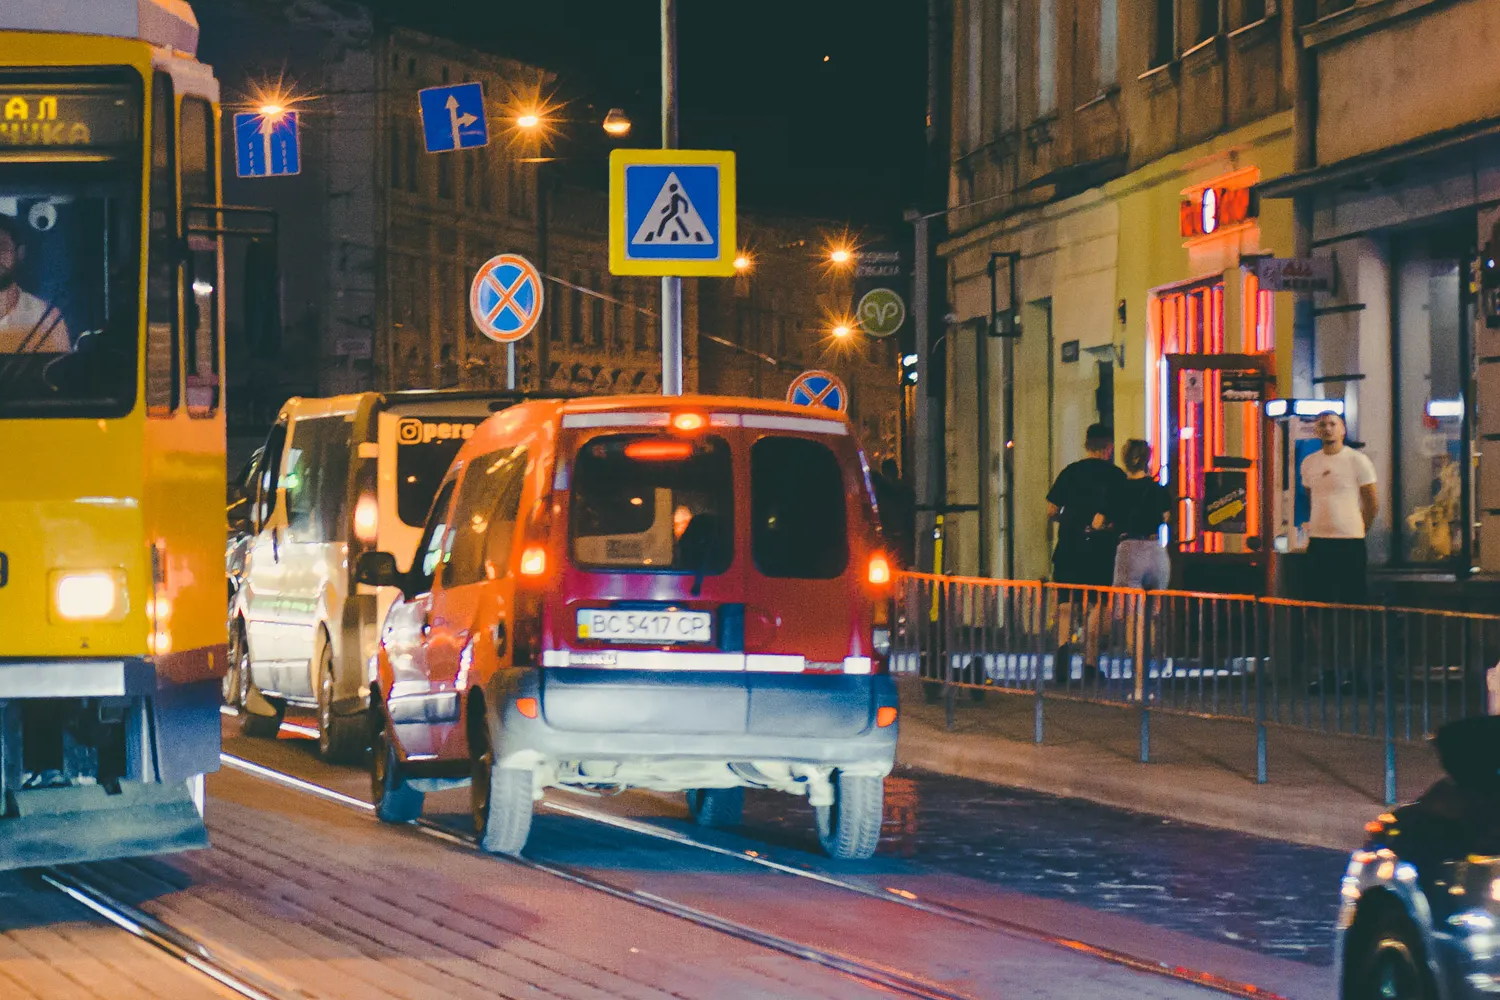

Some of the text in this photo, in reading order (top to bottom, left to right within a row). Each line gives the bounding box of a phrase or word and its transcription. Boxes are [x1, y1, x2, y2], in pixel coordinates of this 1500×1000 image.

[593, 615, 705, 635] BC 5417 CP
